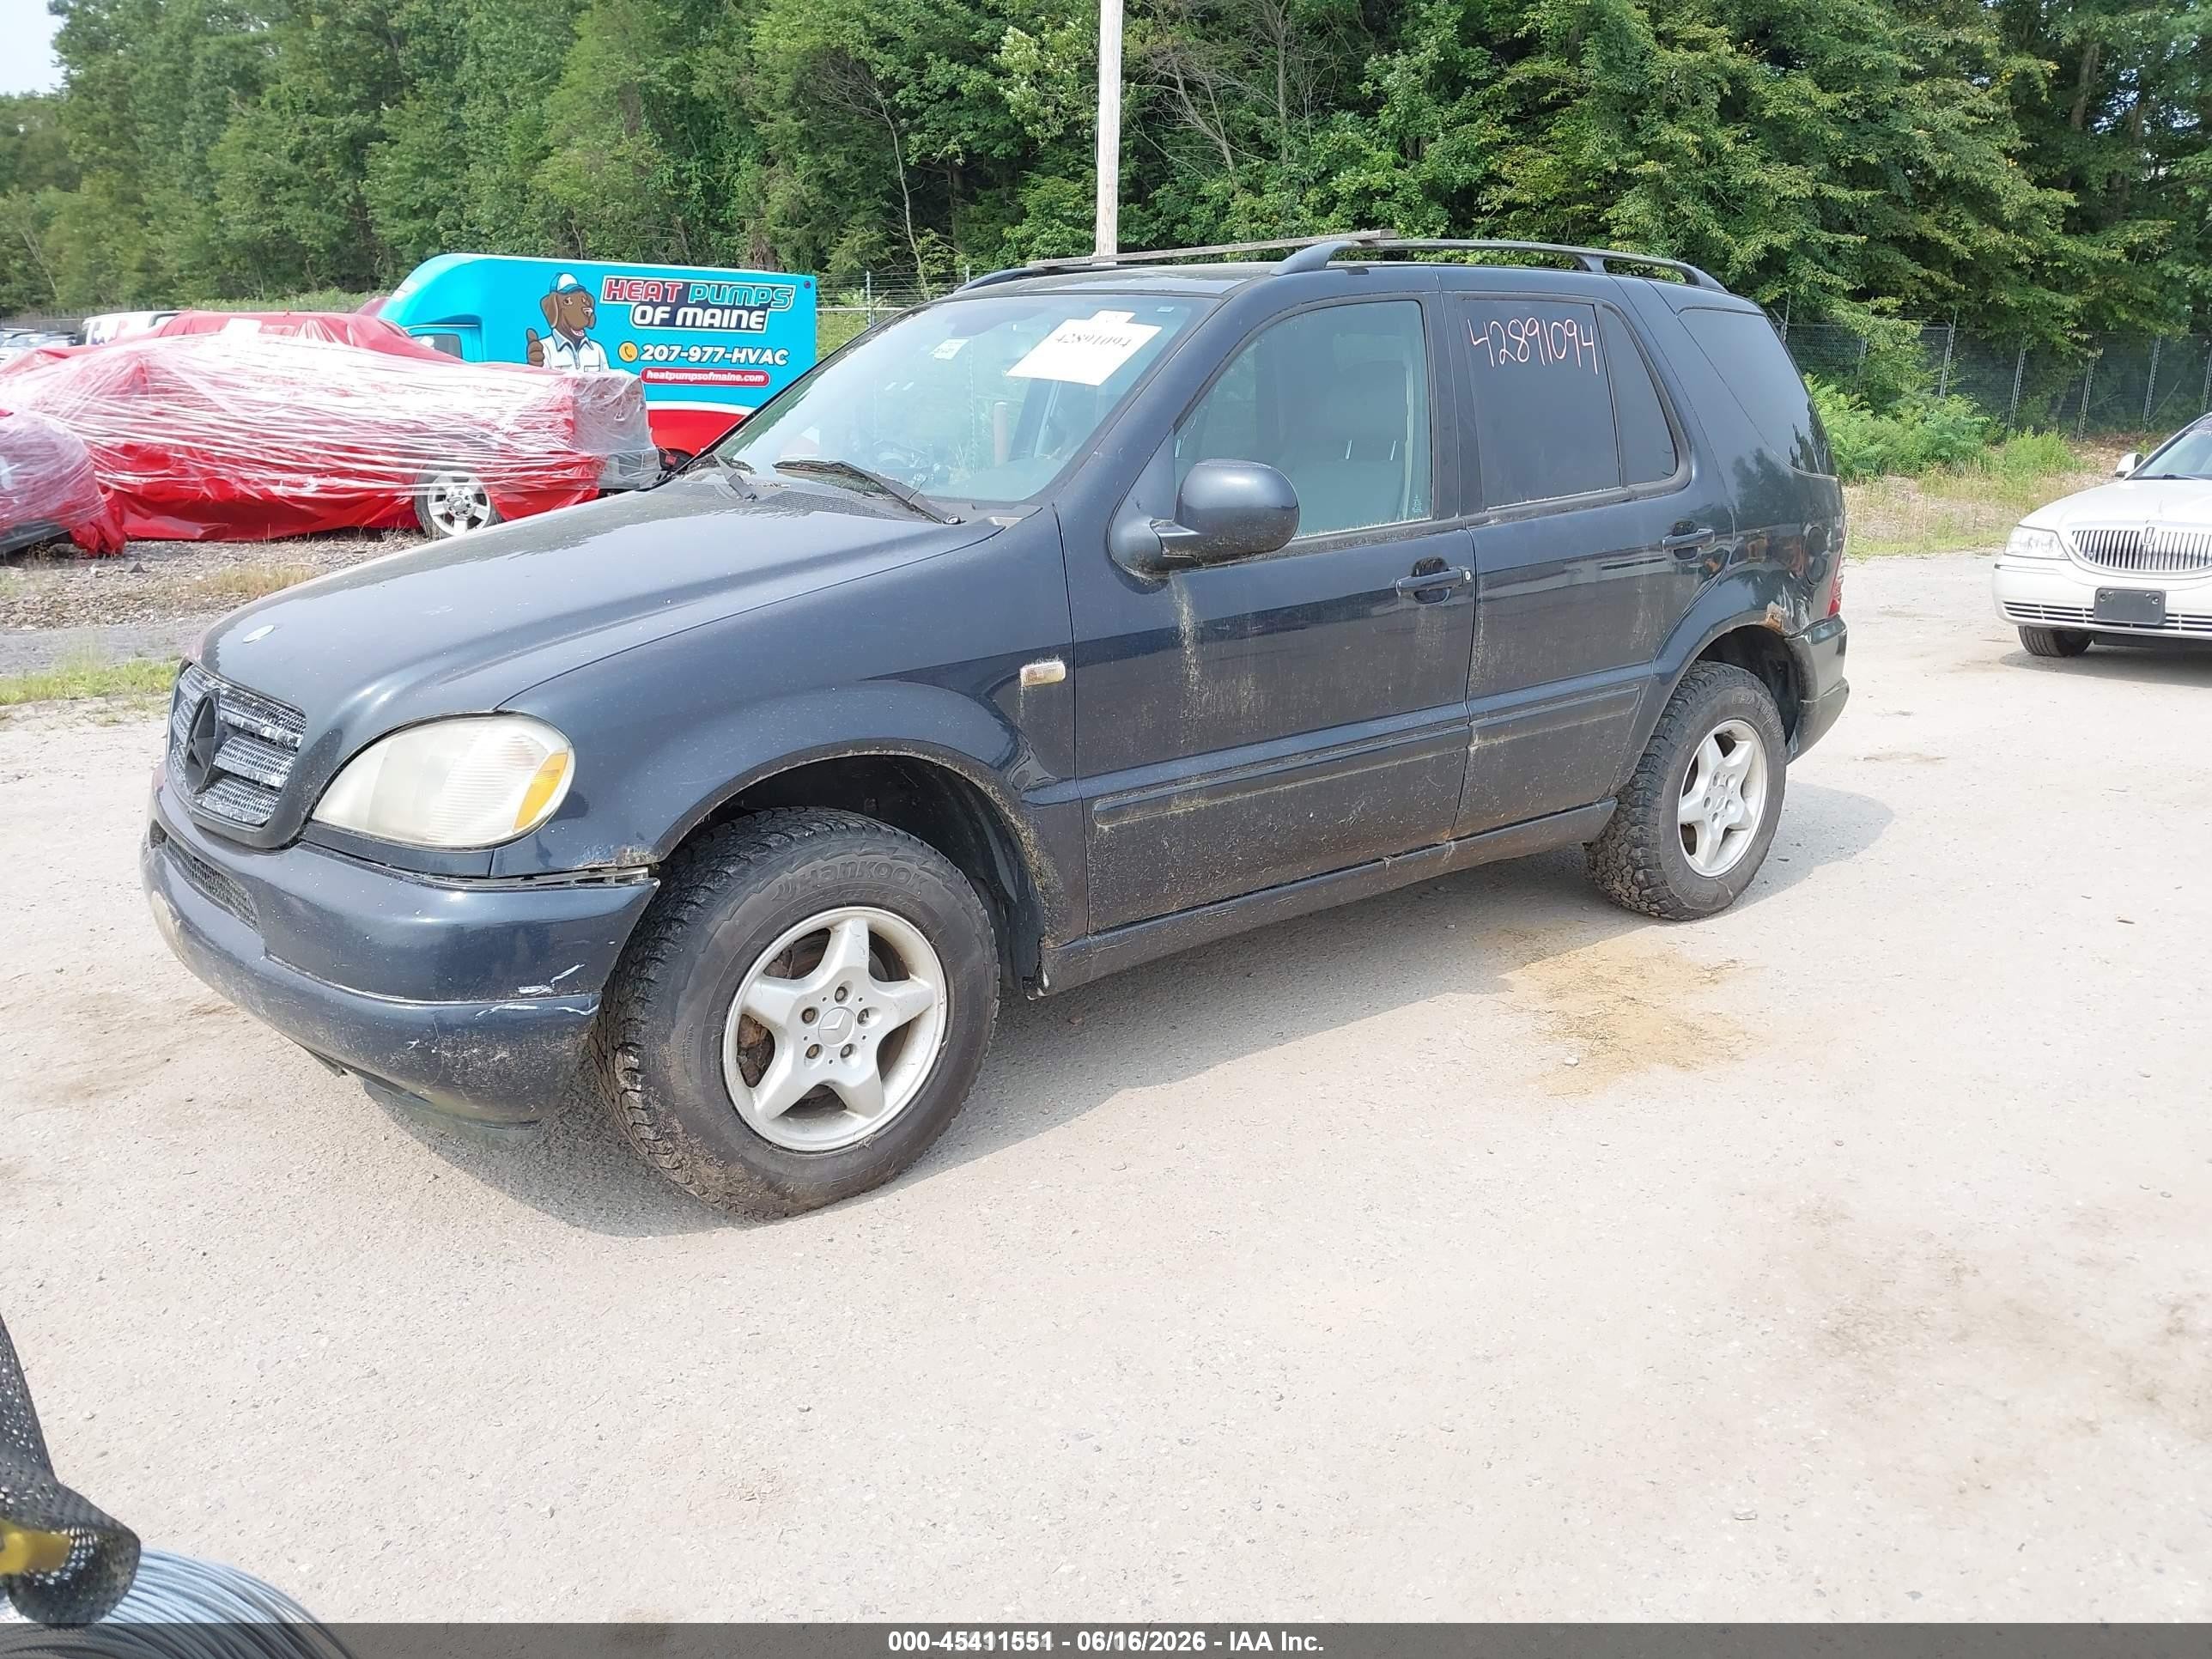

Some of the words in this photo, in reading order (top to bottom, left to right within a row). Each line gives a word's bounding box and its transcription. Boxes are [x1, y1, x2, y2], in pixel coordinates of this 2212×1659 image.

[605, 279, 682, 302] HEAT
[688, 283, 793, 307] PUMPS
[632, 305, 671, 325] OF
[674, 307, 767, 330] MAINE
[640, 344, 789, 367] 207-977-HVAC
[1467, 317, 1598, 375] 42891094
[646, 369, 765, 383] heatpumpsofmaine.com
